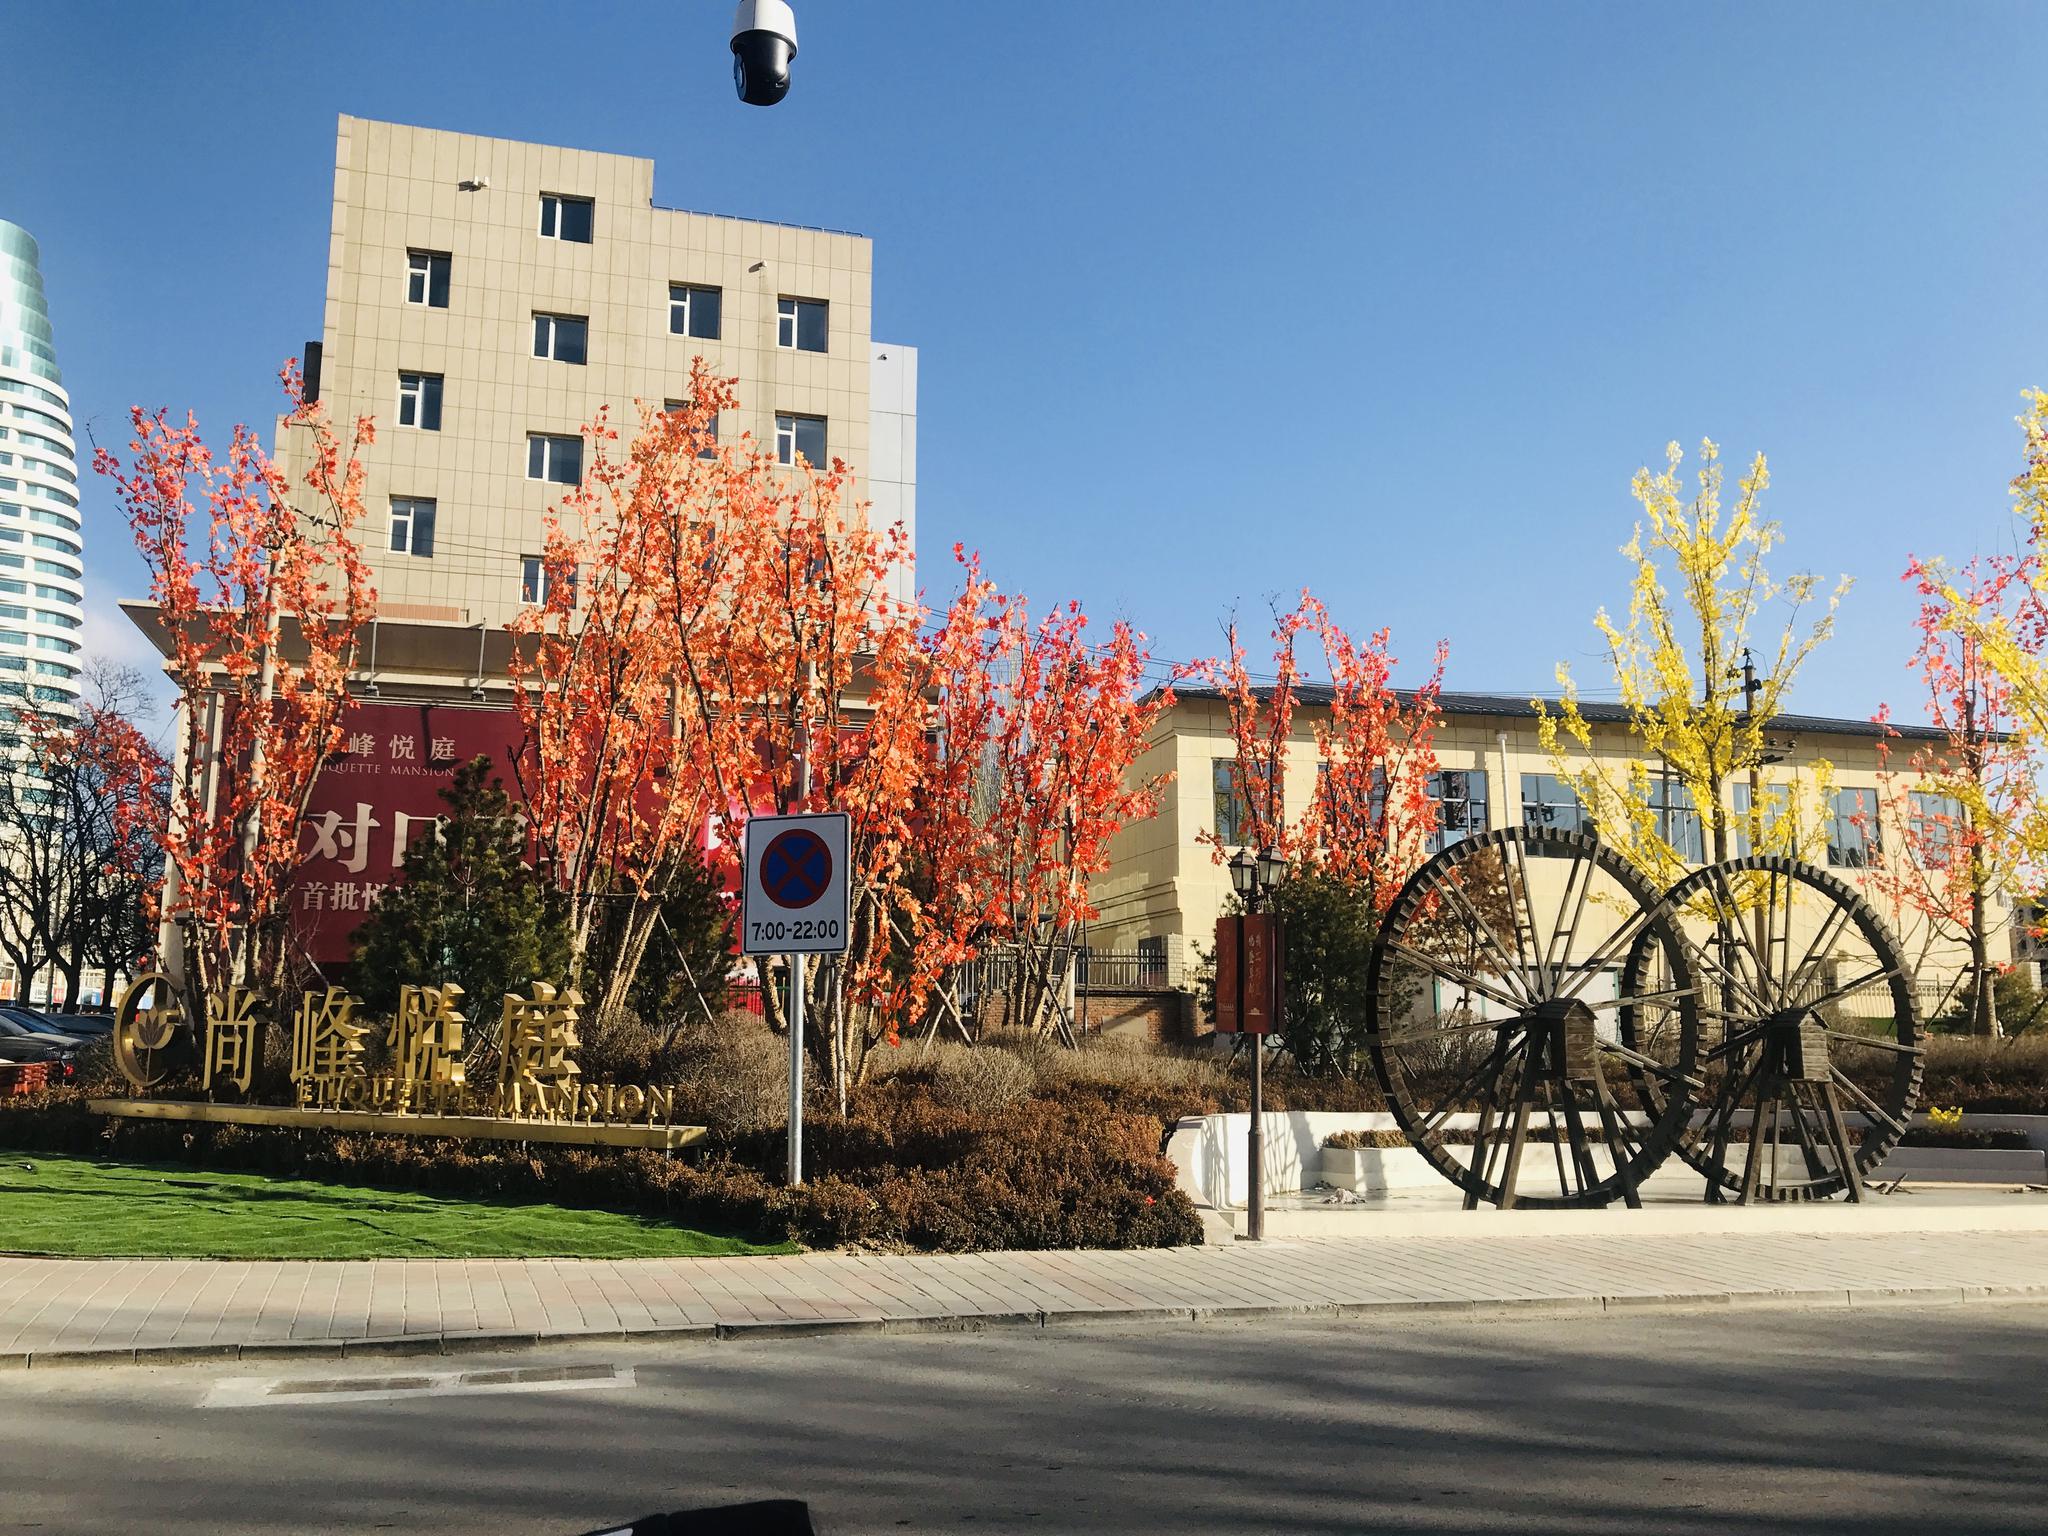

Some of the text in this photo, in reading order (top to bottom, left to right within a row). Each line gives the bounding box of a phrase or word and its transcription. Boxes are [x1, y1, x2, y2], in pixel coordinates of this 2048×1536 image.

[347, 732, 455, 761] 峰悦庭
[320, 762, 455, 777] IQUETTE MANSION
[752, 919, 839, 941] 7:00-22:00
[201, 981, 584, 1094] 尚峰悦庭
[298, 1075, 675, 1117] ETIQUETTE MANSION
